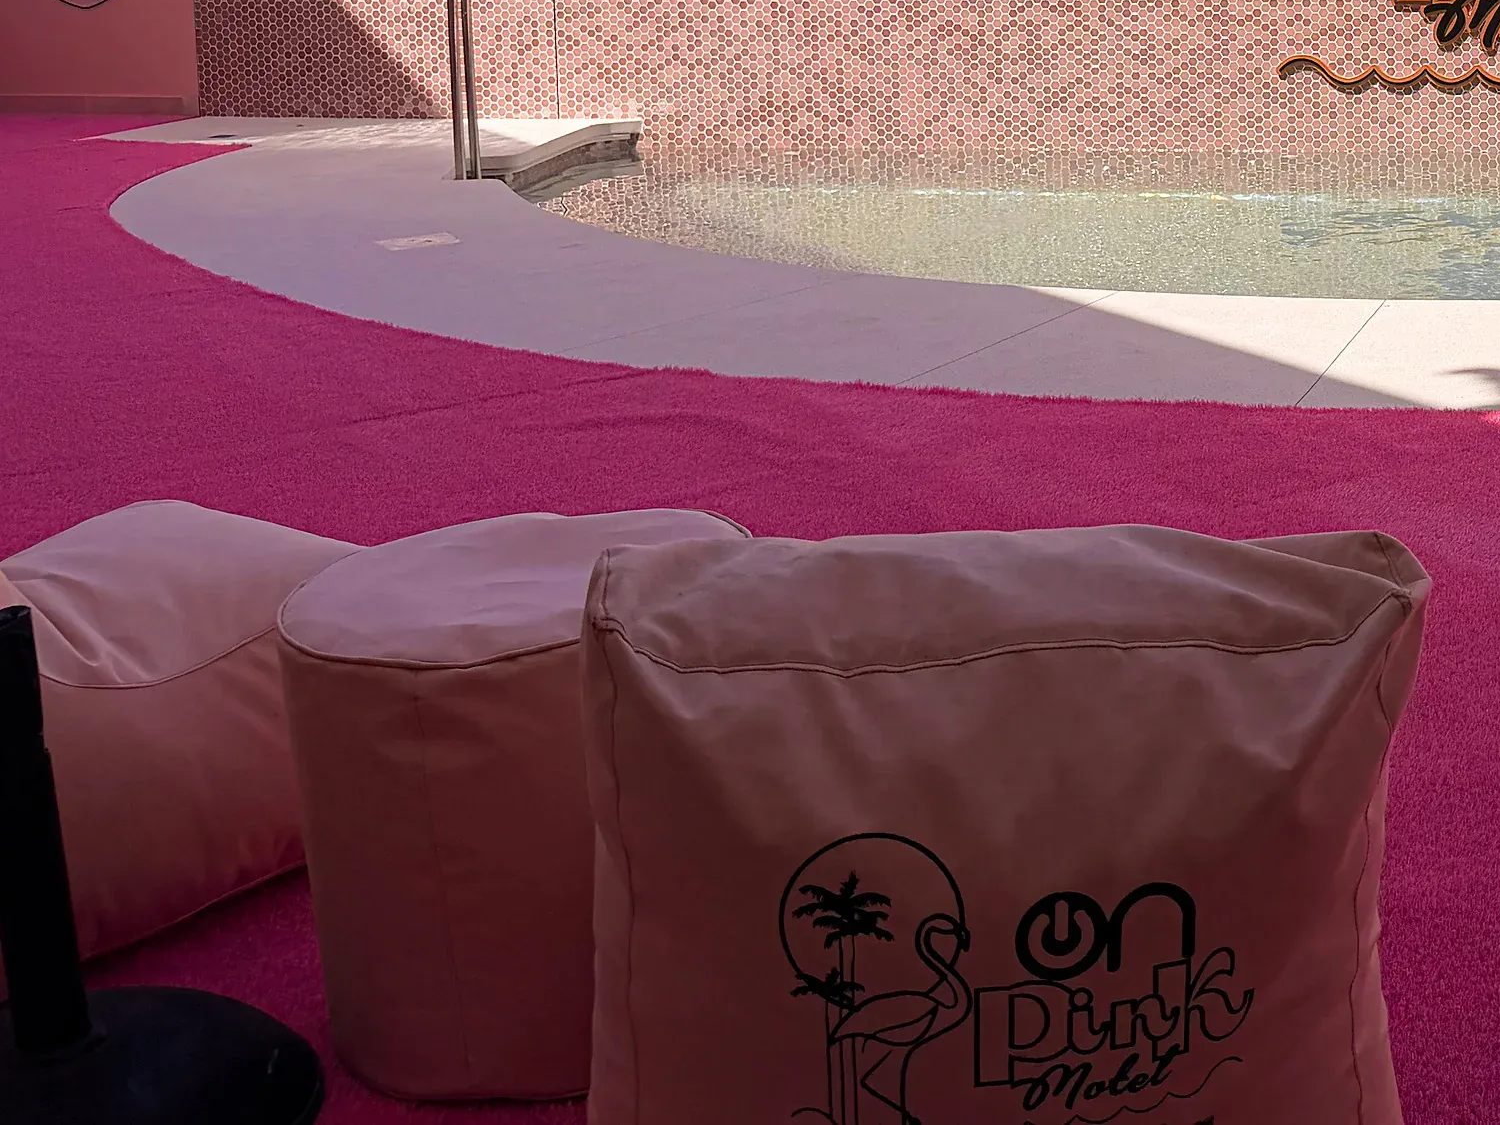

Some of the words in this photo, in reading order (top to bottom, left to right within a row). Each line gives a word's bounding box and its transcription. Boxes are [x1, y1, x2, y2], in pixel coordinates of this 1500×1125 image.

[1015, 881, 1197, 981] on
[973, 946, 1255, 1088] Pink
[1013, 1042, 1182, 1111] Motel
